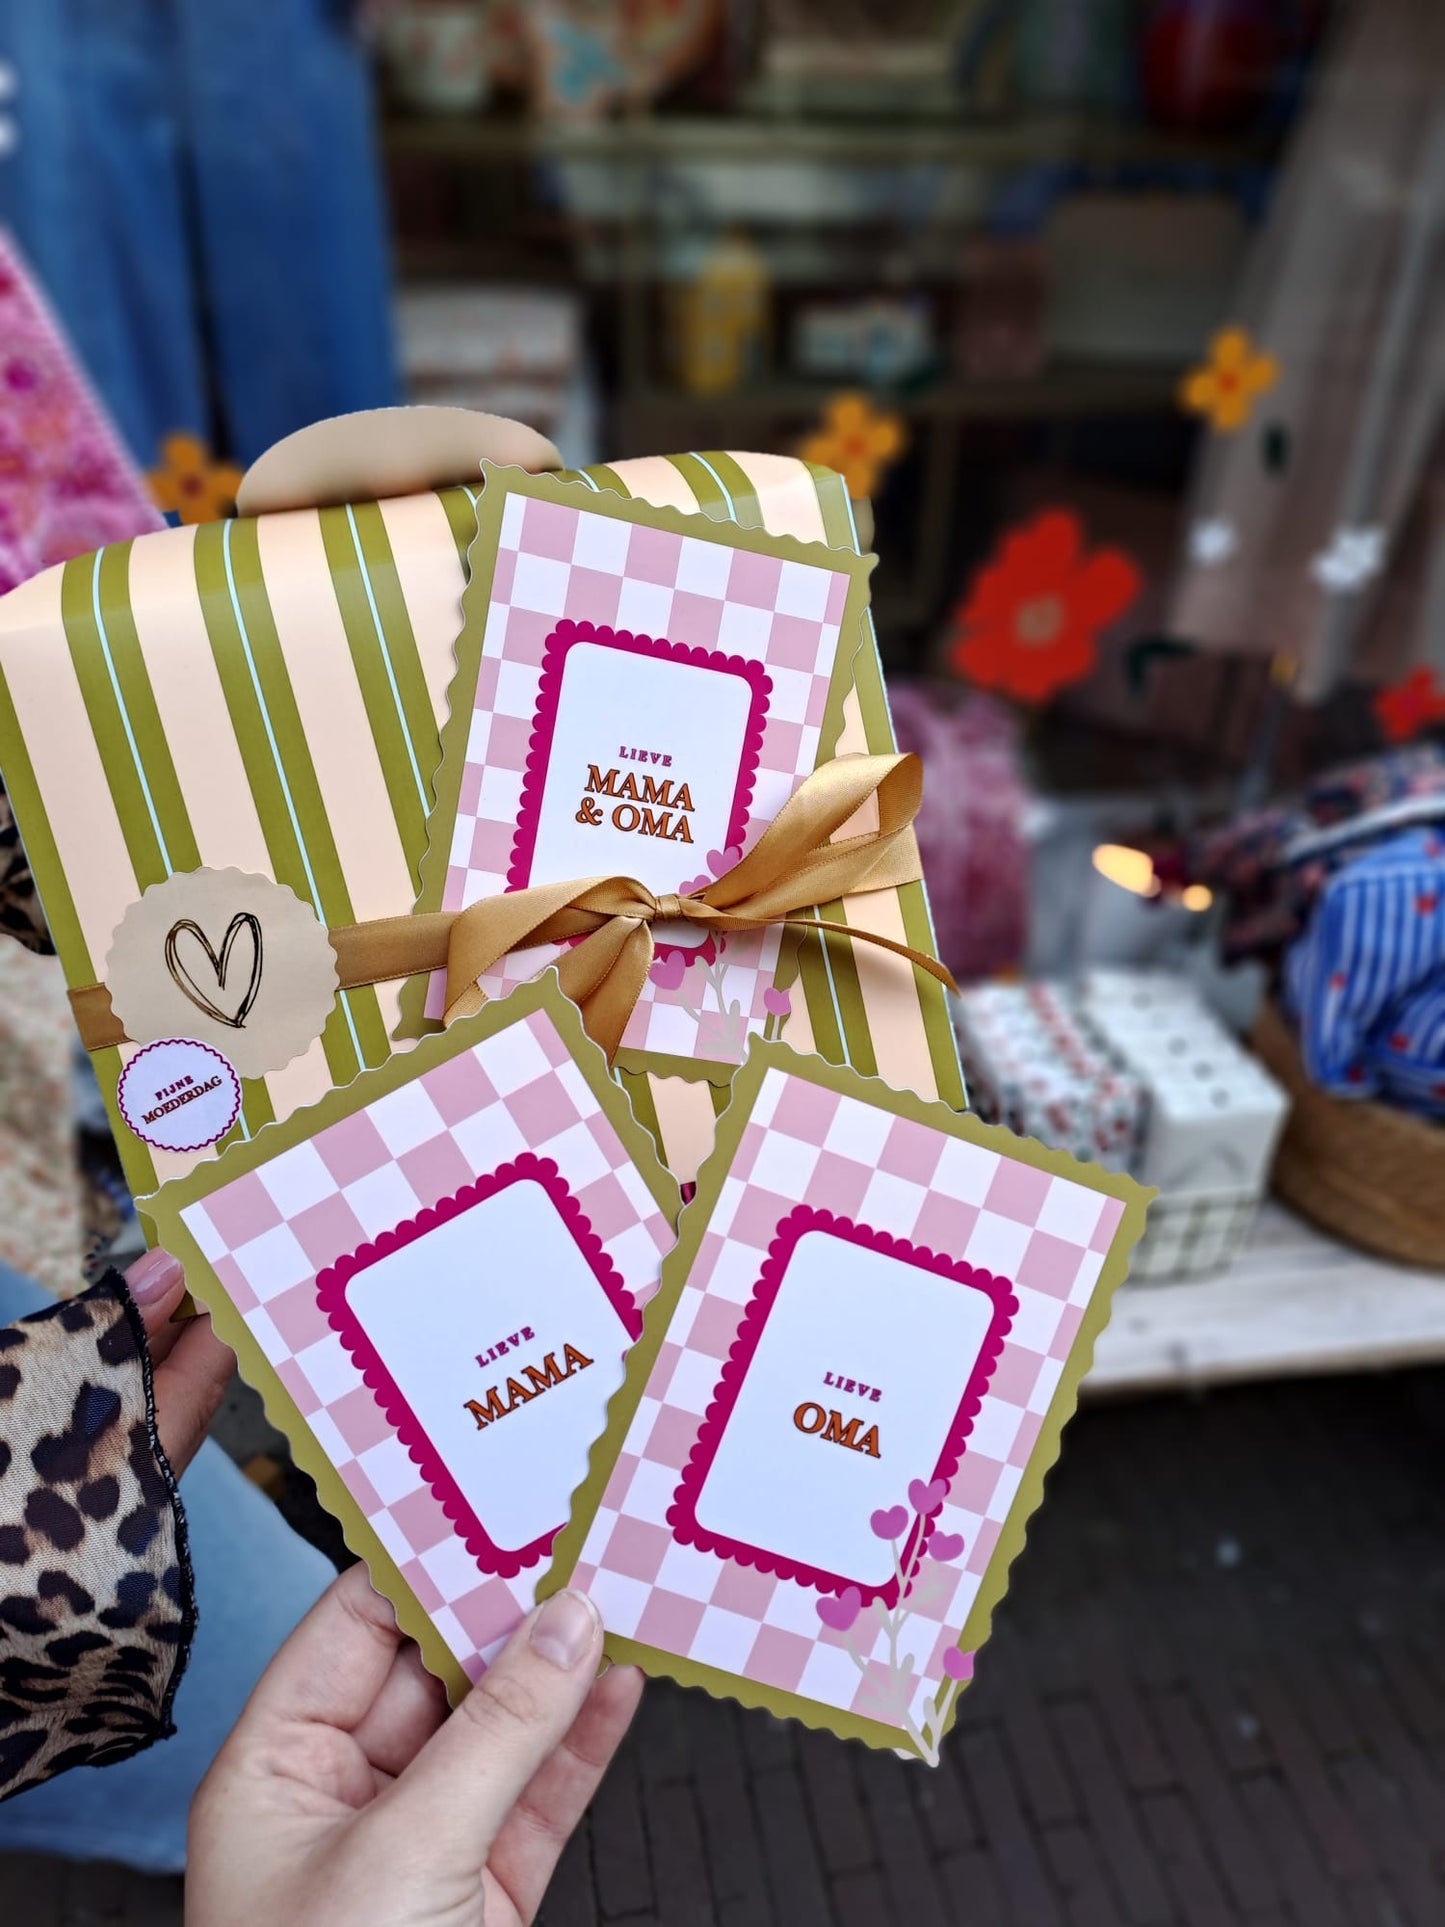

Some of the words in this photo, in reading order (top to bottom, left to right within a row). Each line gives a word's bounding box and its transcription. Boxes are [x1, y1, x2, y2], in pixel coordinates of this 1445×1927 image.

[619, 746, 672, 767] LIEVE
[584, 763, 695, 812] MAMA
[575, 796, 603, 826] &
[611, 804, 694, 844] OMA
[141, 1075, 223, 1124] MOEDERDAG
[155, 1075, 194, 1100] FIJNE
[475, 1326, 535, 1368] LIEVE
[463, 1343, 595, 1431] MAMA
[823, 1371, 882, 1402] LIEVE
[793, 1402, 881, 1459] OMA
